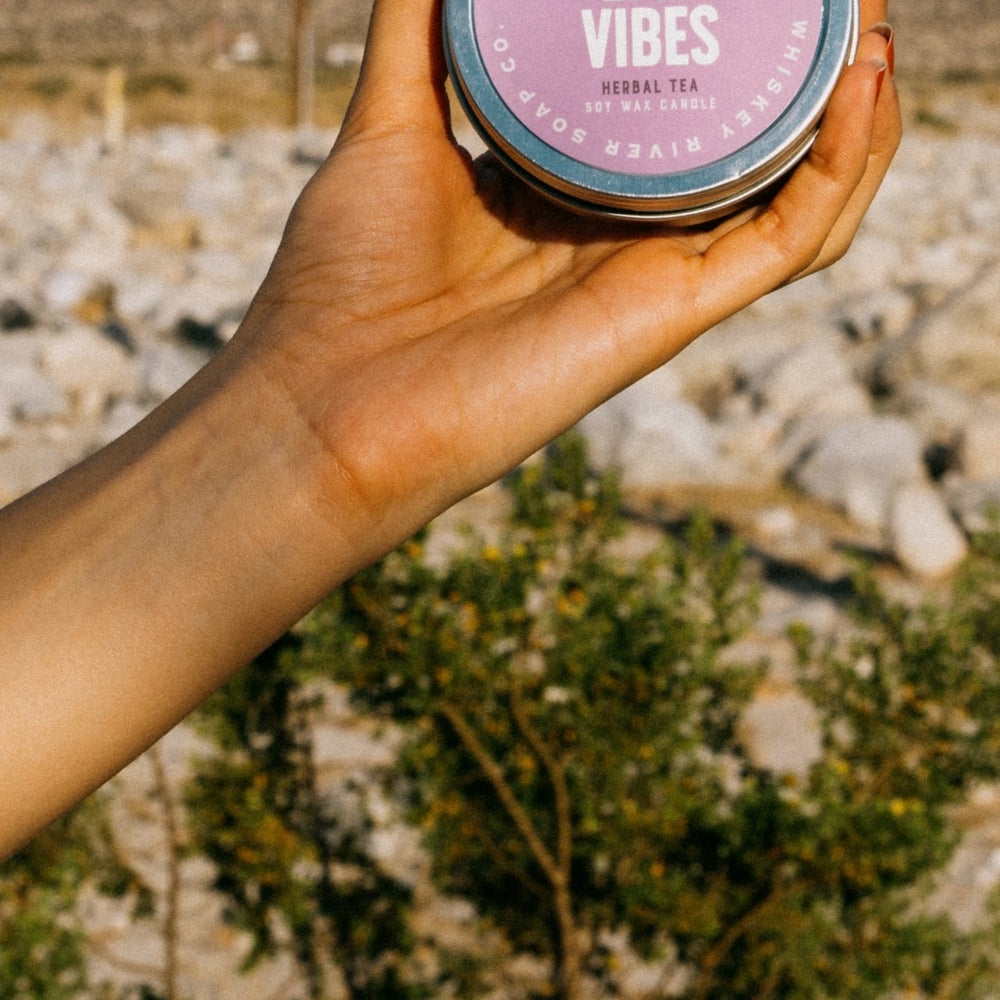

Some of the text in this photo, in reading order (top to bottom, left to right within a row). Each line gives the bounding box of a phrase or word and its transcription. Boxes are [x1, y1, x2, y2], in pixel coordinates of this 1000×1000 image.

[581, 5, 720, 69] VIBES
[602, 78, 699, 95] HERBAL TEA
[721, 20, 808, 140] WHISKEY
[519, 88, 586, 145] SOAP
[585, 97, 717, 113] SOY WAX CANDLE
[604, 135, 702, 160] RIVER
